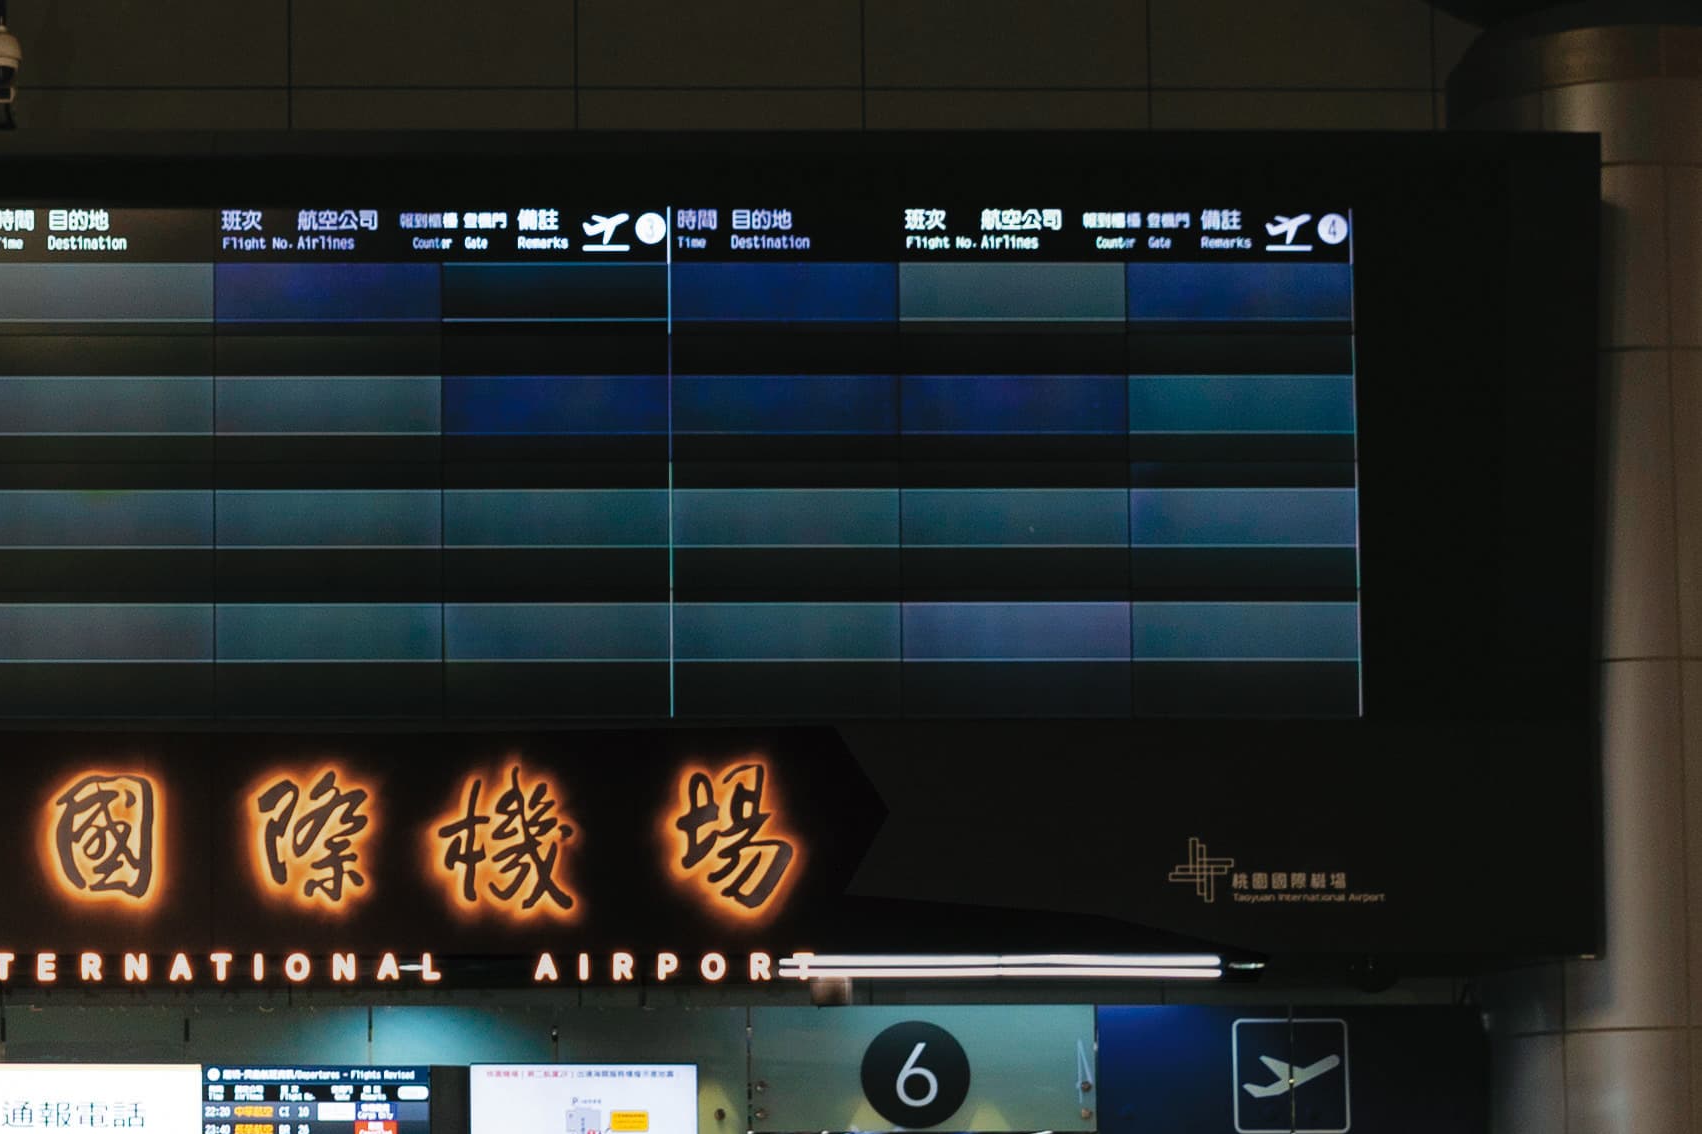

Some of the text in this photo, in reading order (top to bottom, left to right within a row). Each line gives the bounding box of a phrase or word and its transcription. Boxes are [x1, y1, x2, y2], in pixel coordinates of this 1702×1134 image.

[48, 208, 110, 232] 目的地
[904, 208, 947, 231] 班次
[47, 234, 128, 251] Destination
[1200, 235, 1252, 249] Remarks
[1232, 872, 1346, 889] 桃園國際機場
[1234, 893, 1385, 903] Taoyuan International Airport
[533, 951, 815, 981] AIRPORT
[895, 1041, 938, 1108] 6
